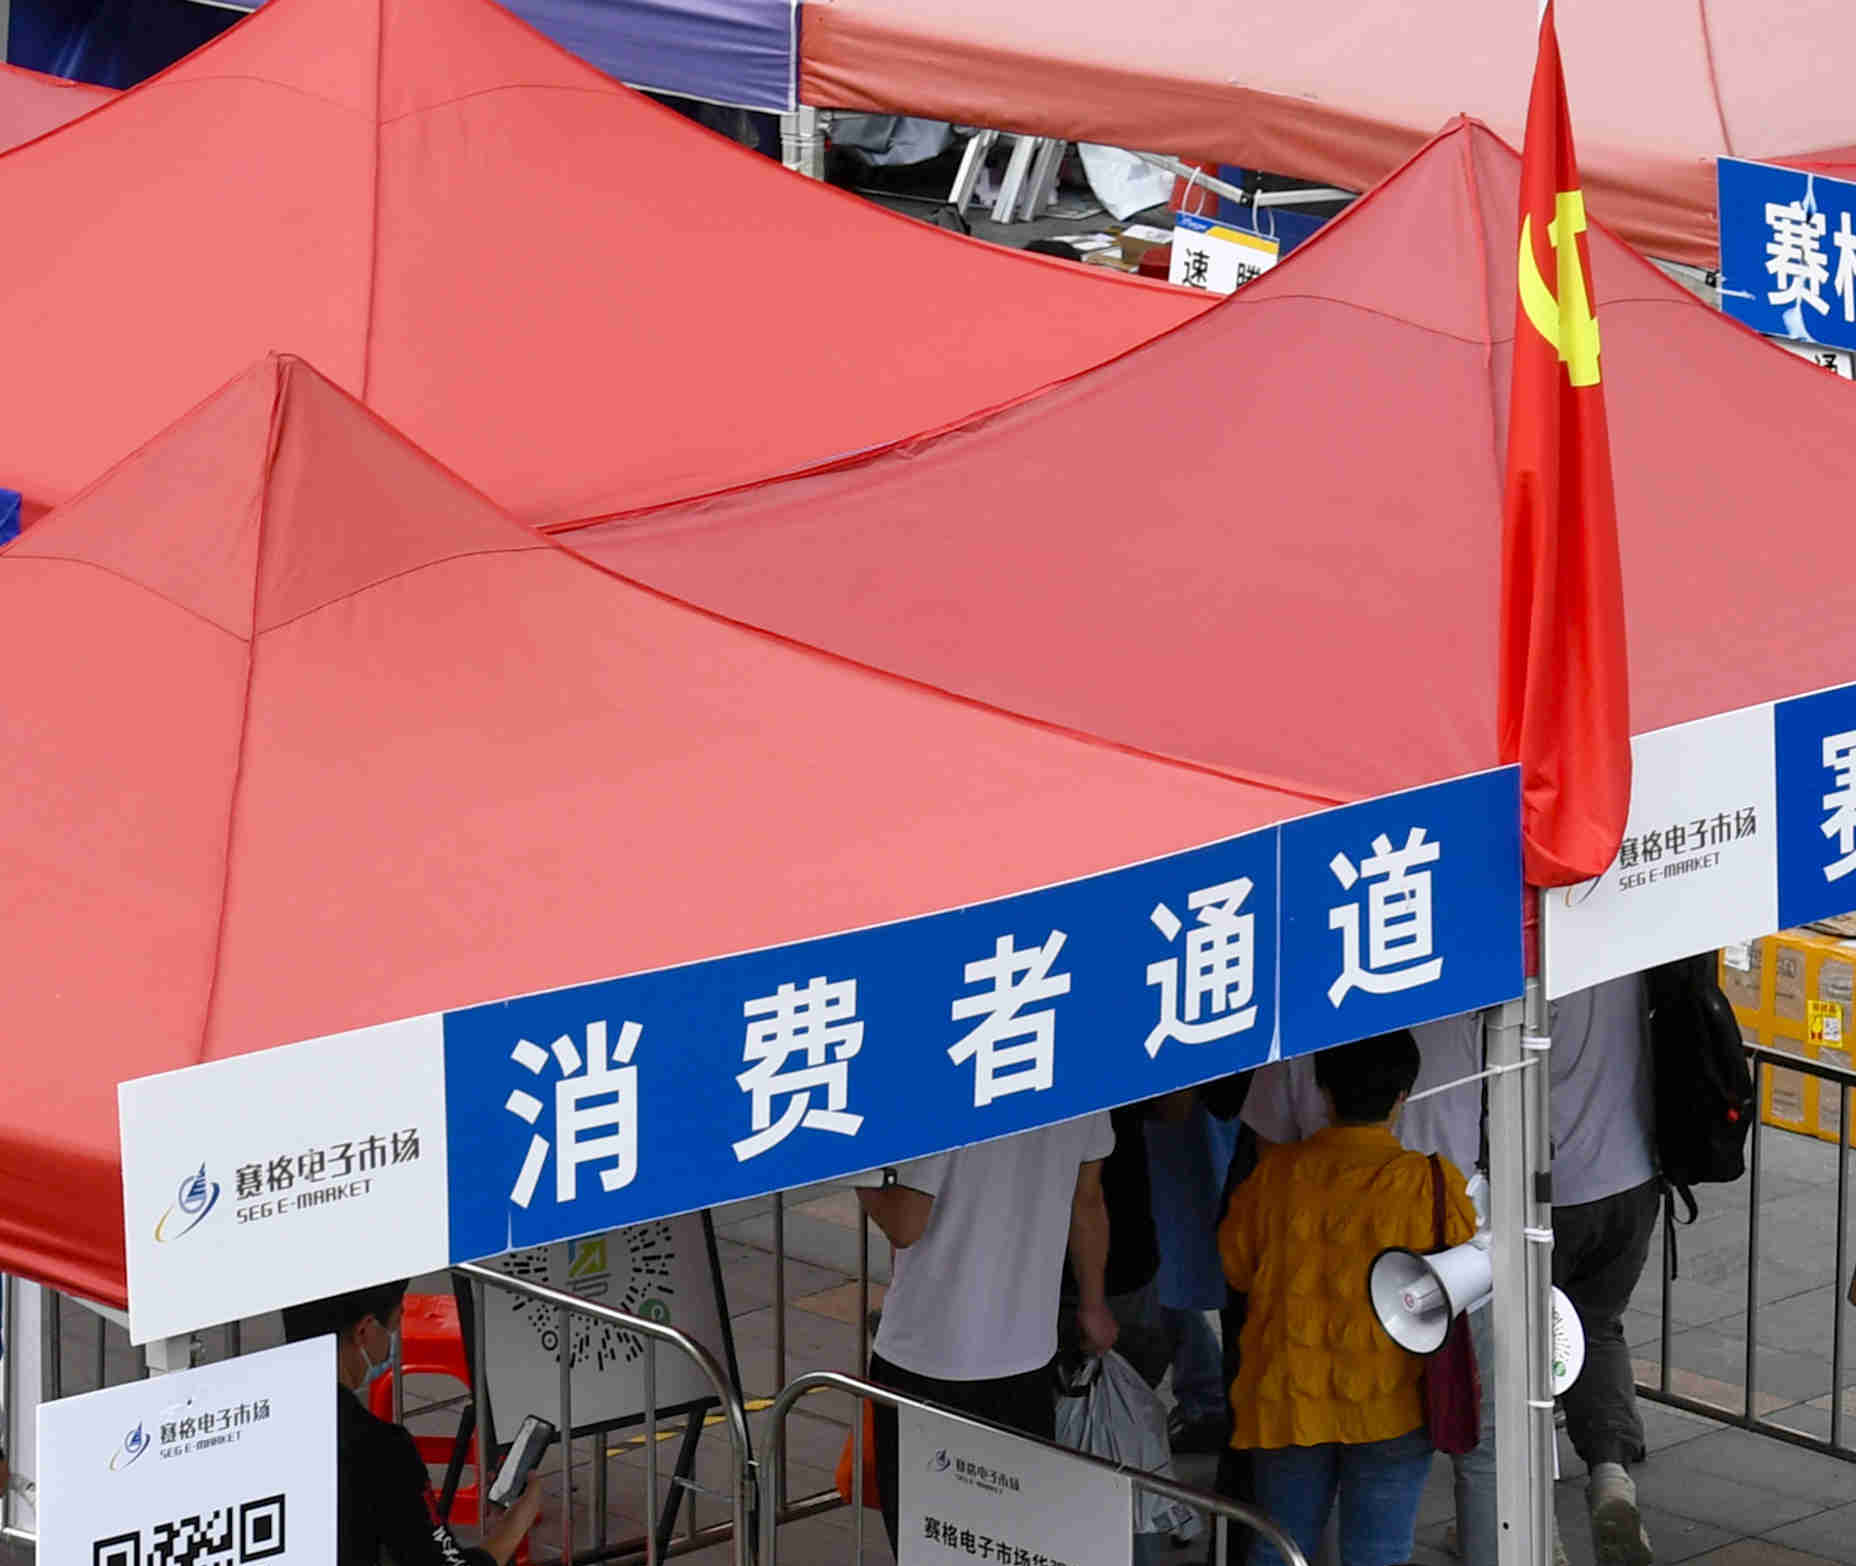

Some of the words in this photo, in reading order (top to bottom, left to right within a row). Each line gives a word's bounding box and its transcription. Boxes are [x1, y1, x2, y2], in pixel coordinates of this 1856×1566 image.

[1619, 806, 1757, 870] 赛格电子市场
[1619, 871, 1647, 891] SEG
[1649, 851, 1721, 883] E-MARKET
[503, 825, 1445, 1209] 消费者通道
[235, 1127, 420, 1201] 赛格电子市场
[236, 1200, 273, 1225] SEG
[277, 1178, 374, 1214] E-MARKET
[159, 1398, 272, 1445] 赛格电子市场
